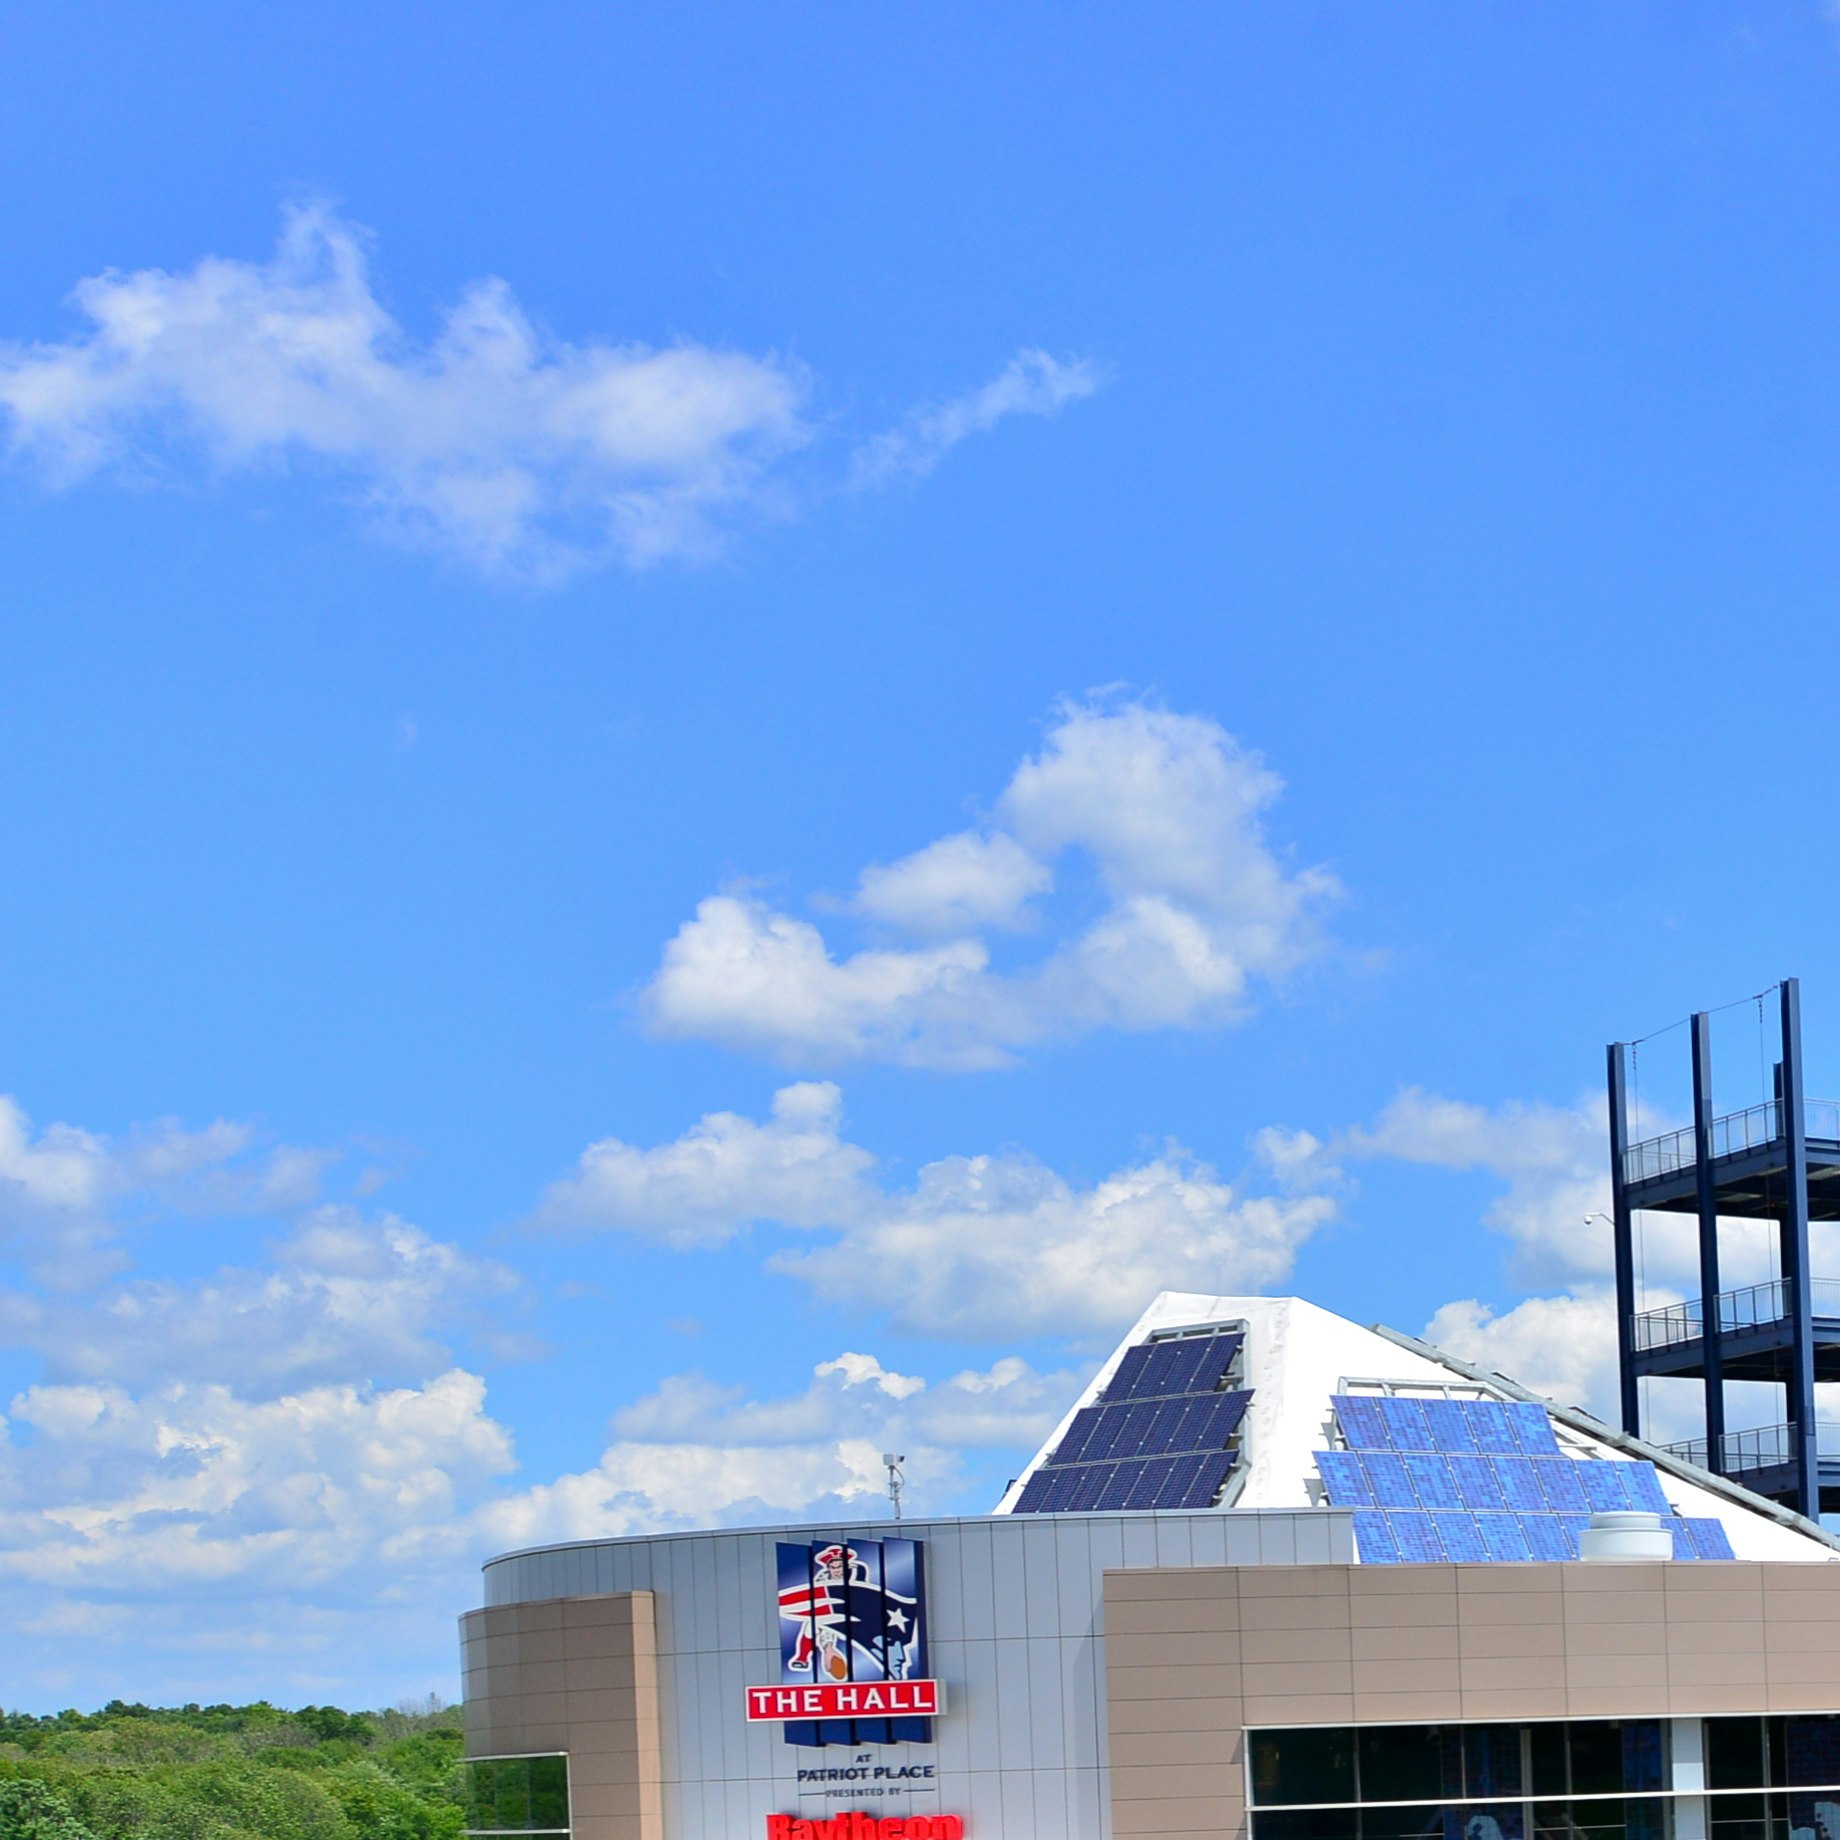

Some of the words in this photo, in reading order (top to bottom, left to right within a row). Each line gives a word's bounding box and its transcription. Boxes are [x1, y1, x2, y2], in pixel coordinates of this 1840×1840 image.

[752, 1690, 822, 1714] THE
[836, 1686, 932, 1711] HALL
[855, 1754, 872, 1763] AT
[797, 1767, 869, 1782] PATRIOT
[873, 1765, 935, 1779] PLACE
[825, 1787, 884, 1798] PRESENTED
[888, 1787, 901, 1796] BY
